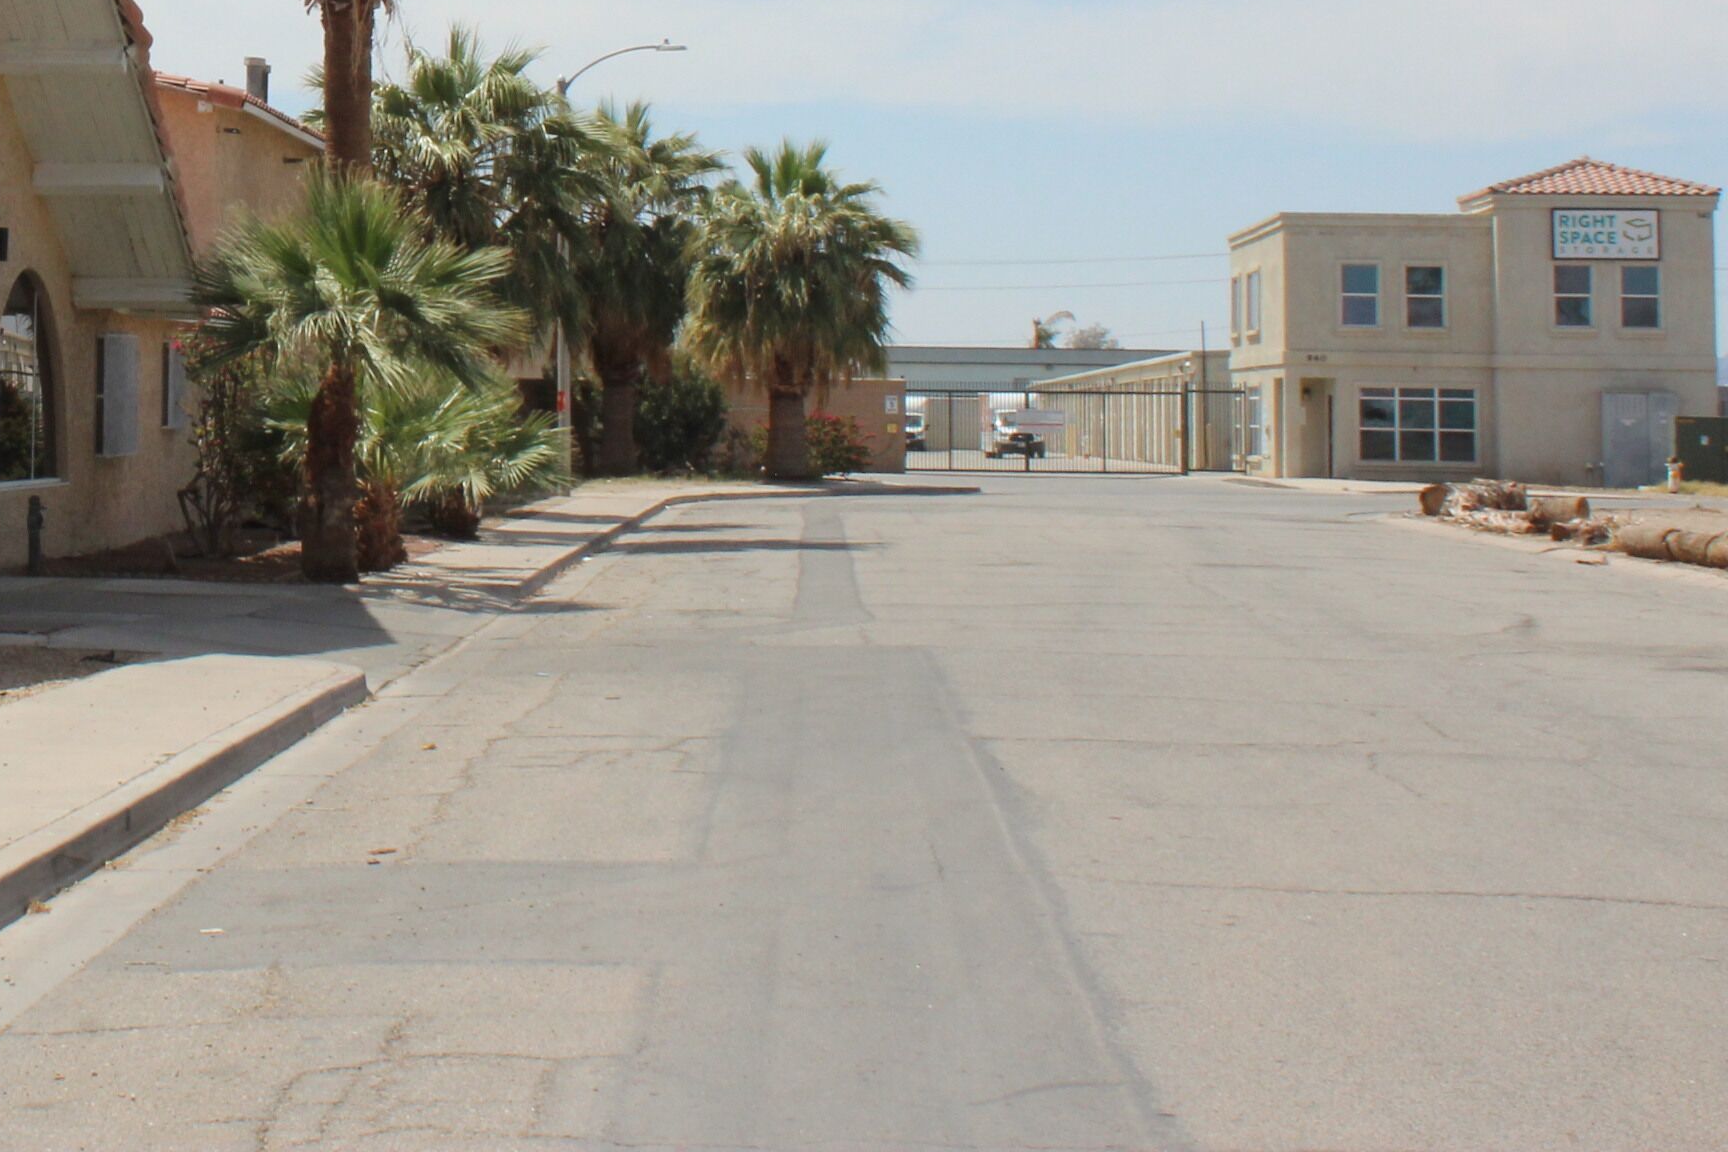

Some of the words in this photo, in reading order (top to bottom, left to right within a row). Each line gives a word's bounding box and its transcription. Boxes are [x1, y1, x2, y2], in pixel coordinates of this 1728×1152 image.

[1559, 215, 1616, 228] RIGHT
[1559, 231, 1616, 245] SPACE
[1559, 246, 1654, 255] STORAGE
